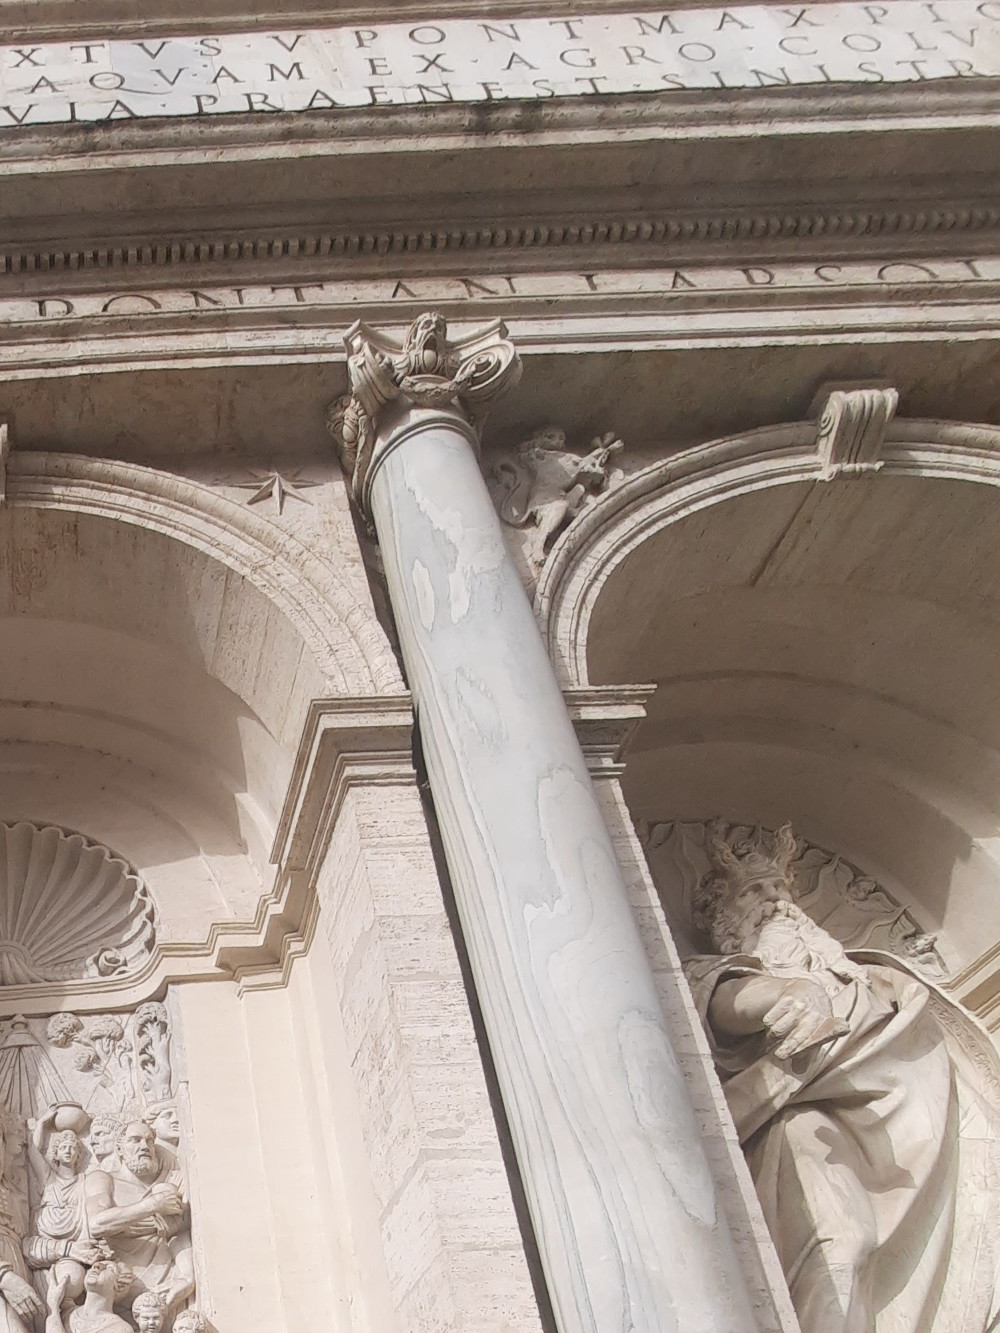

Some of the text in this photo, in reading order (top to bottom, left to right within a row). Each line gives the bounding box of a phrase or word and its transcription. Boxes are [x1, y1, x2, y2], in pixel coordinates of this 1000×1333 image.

[267, 34, 303, 53] V
[353, 19, 583, 49] PONT
[634, 9, 824, 36] MAX
[24, 28, 979, 95] AQVAM EX AGRO COLV
[0, 95, 138, 125] VIA
